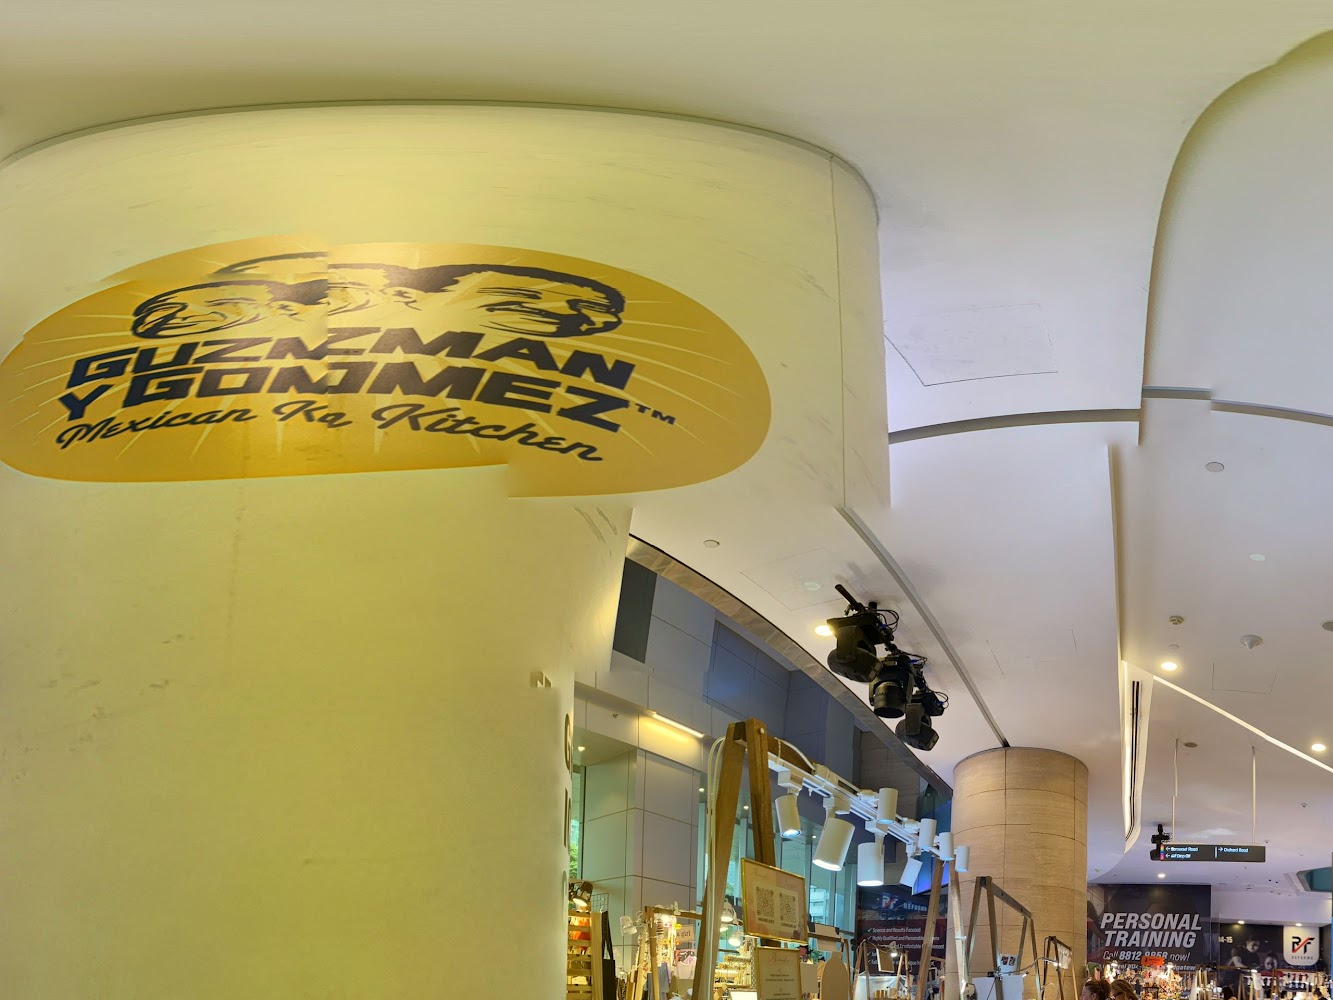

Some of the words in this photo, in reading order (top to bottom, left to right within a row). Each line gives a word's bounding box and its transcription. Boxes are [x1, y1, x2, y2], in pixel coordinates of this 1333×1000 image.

[58, 384, 114, 422] Y
[55, 406, 257, 450] Mexican
[371, 403, 603, 461] Kitchen
[1100, 912, 1202, 931] PERSONAL
[1104, 930, 1197, 949] TRAINING
[1103, 950, 1119, 961] Call
[1119, 950, 1142, 961] 8812
[1170, 952, 1190, 962] now!
